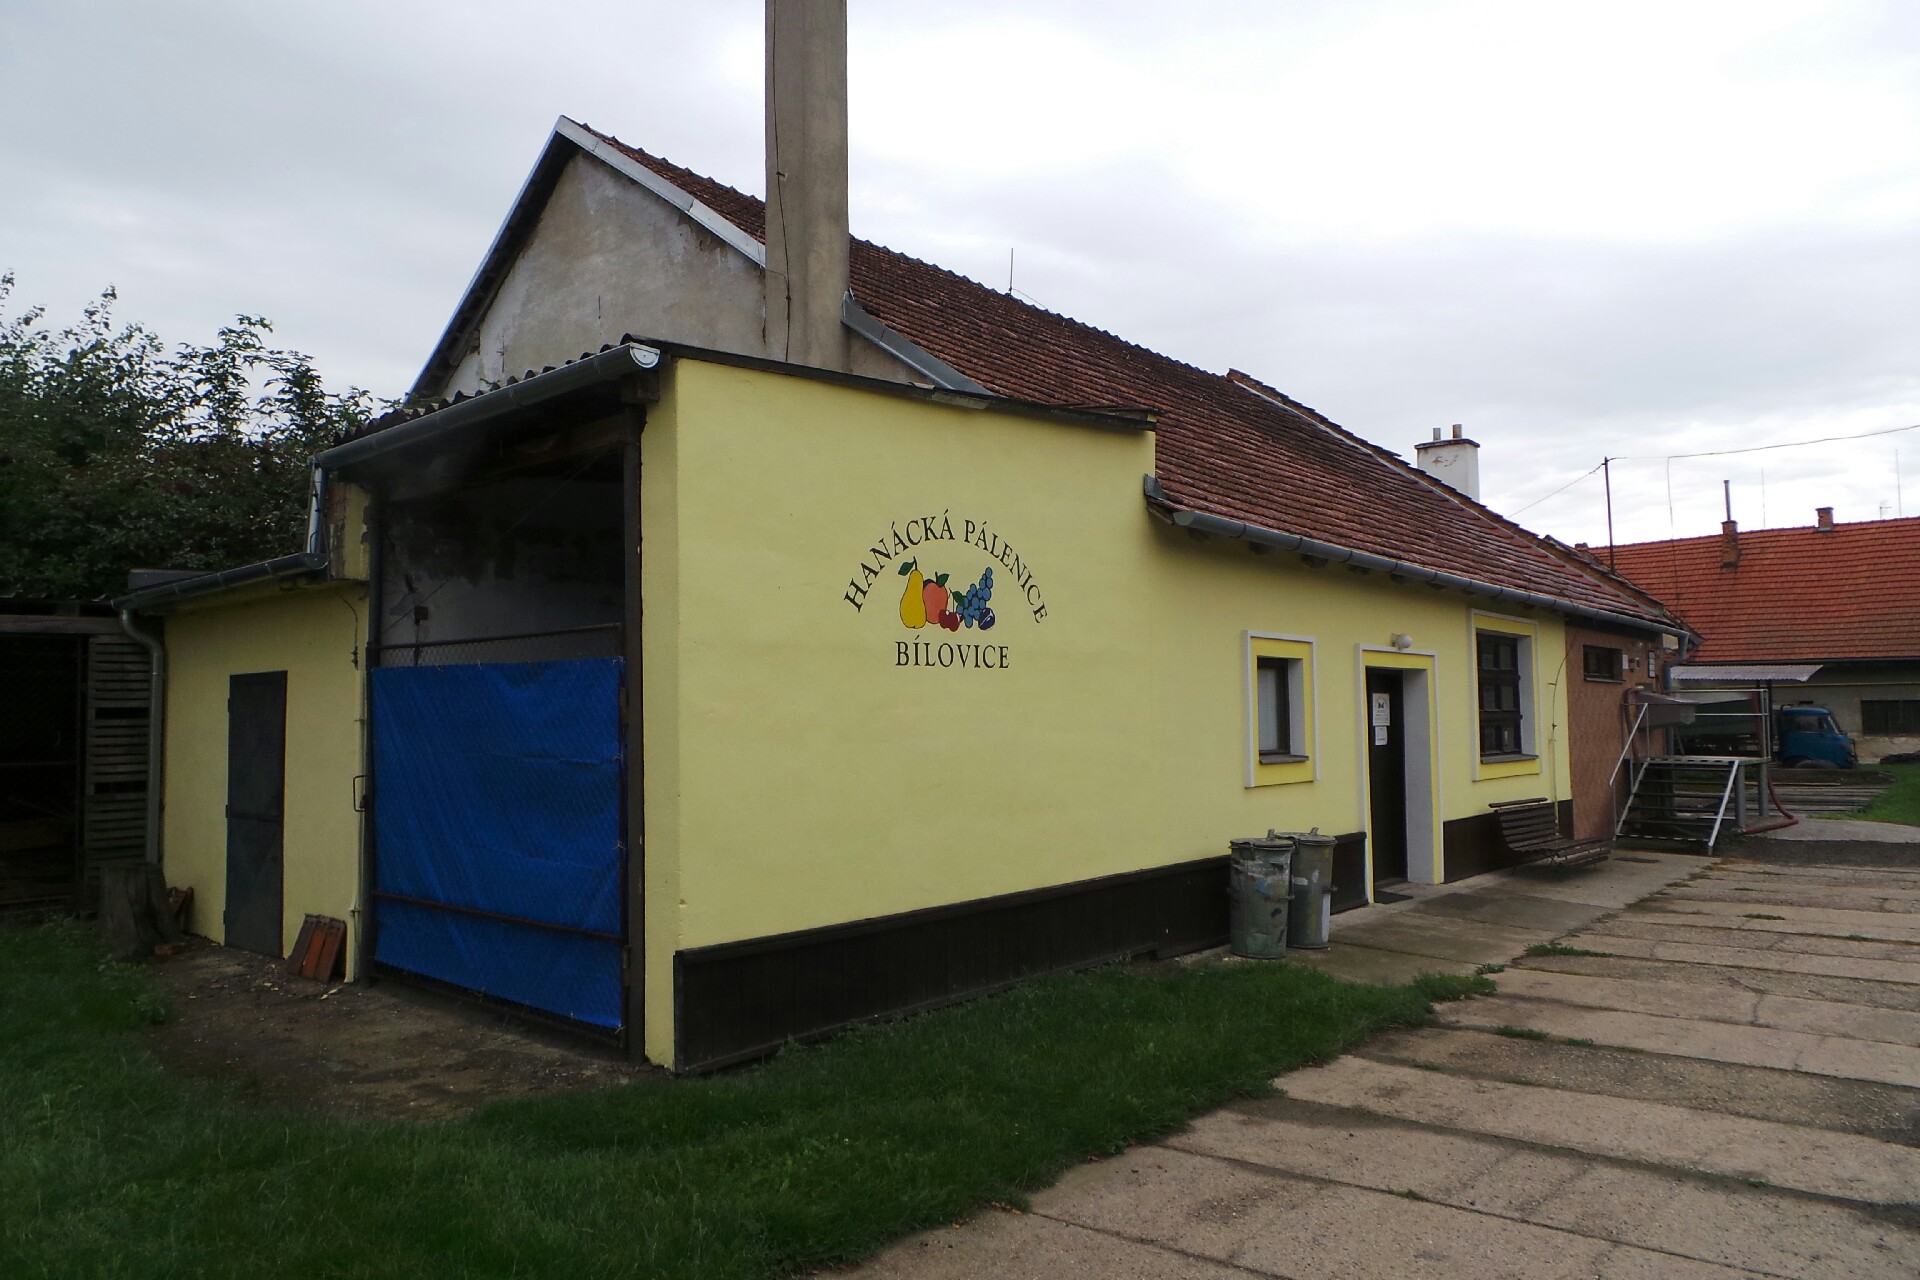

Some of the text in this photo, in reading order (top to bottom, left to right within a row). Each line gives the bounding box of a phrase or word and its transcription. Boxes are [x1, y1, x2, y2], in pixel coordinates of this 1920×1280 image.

[844, 508, 1048, 624] HANÁCKÁ PÁLENICE
[895, 634, 1010, 669] BÍLOVICE
